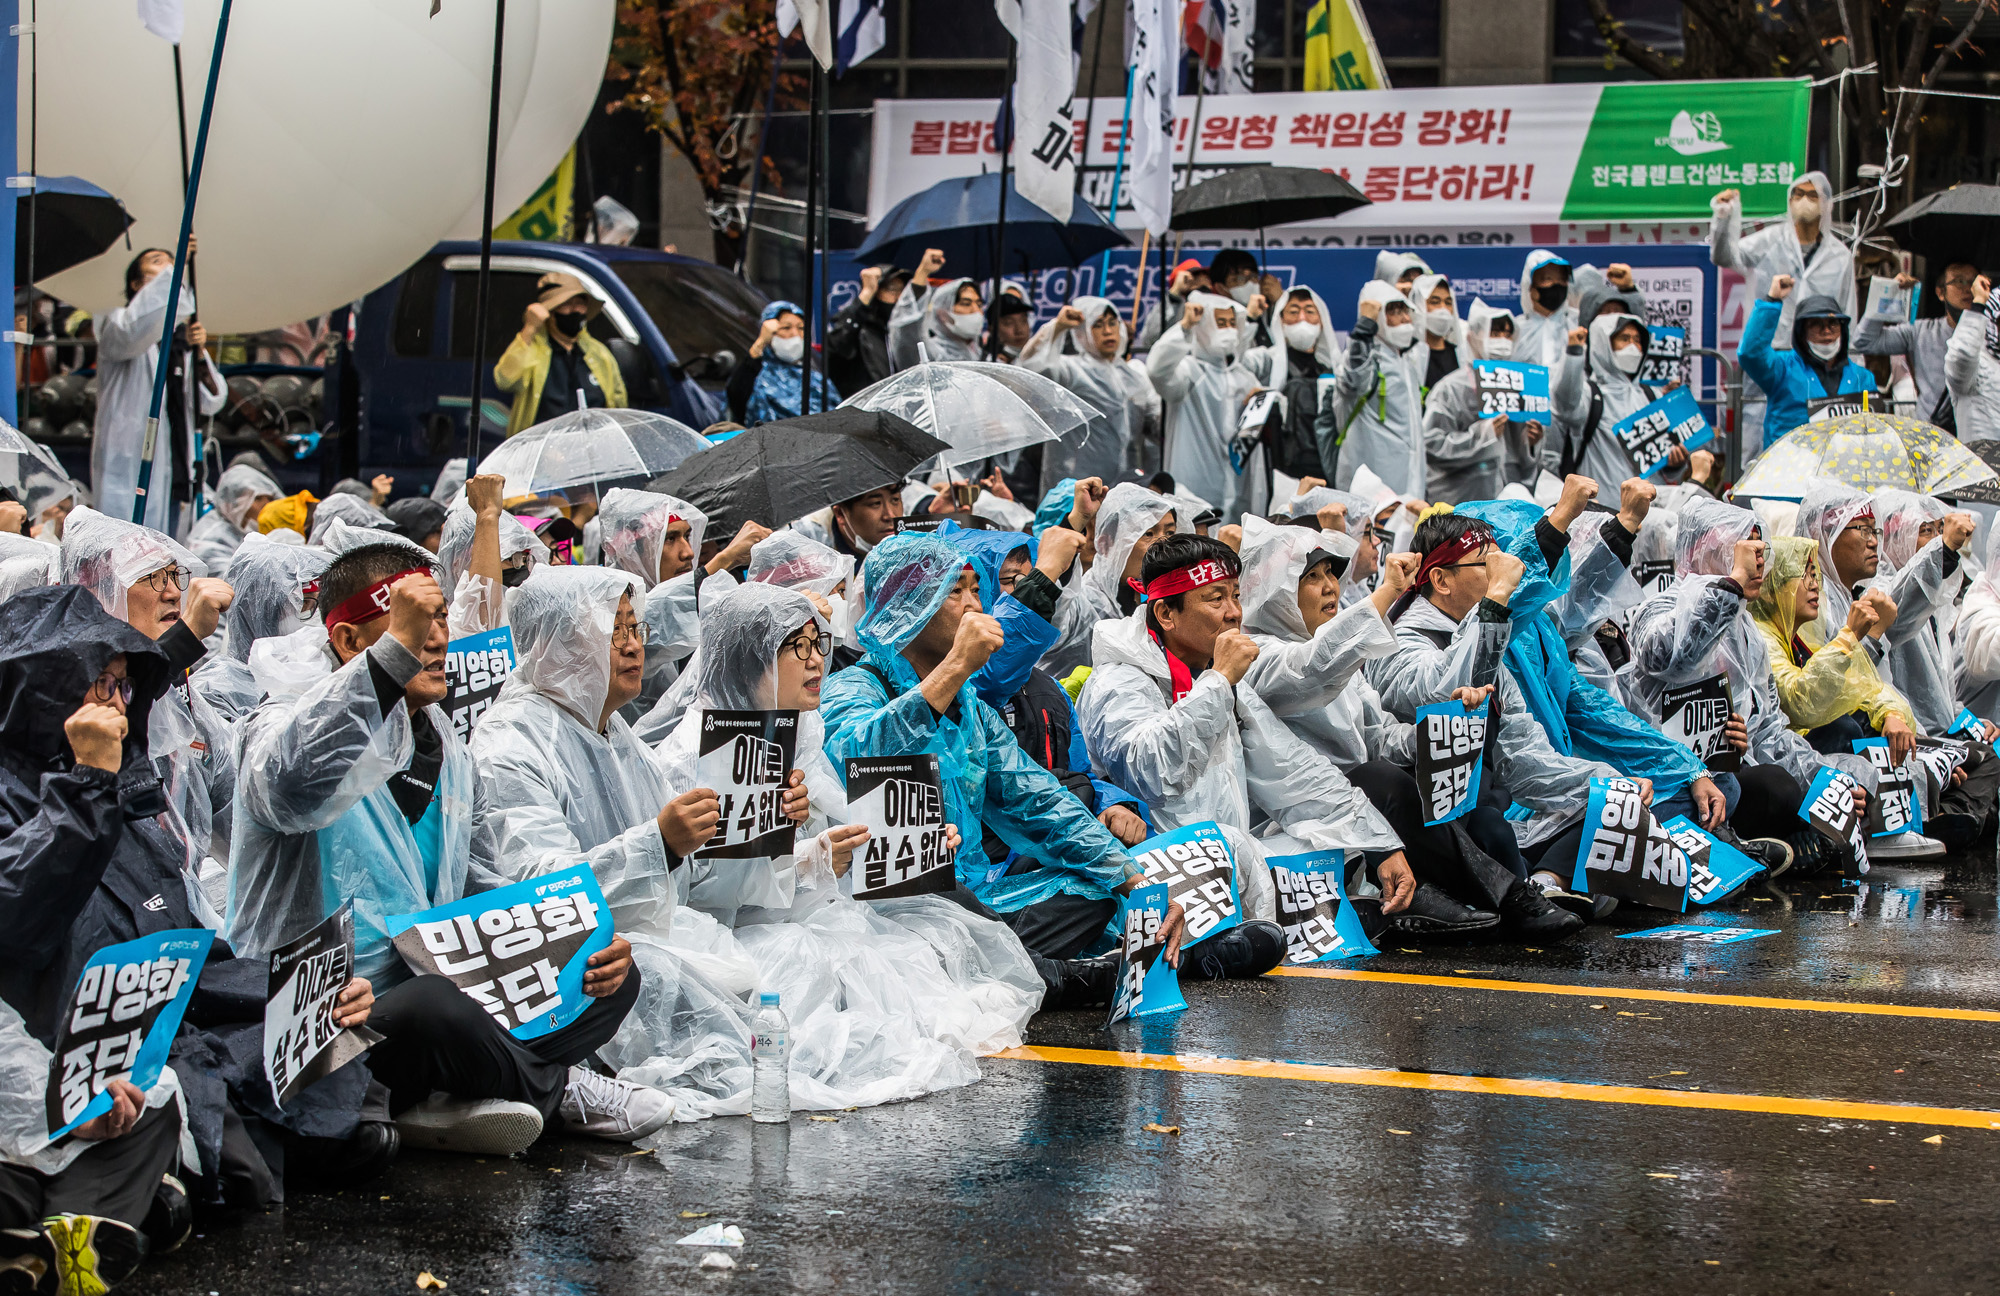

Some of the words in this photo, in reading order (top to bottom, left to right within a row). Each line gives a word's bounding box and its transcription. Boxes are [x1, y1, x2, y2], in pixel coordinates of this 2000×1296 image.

[1201, 115, 1278, 151] 원청
[1289, 110, 1407, 148] 책임성
[1417, 108, 1512, 146] 강화!
[1363, 163, 1535, 202] 중단하라!
[1591, 162, 1796, 187] 전국플랜트건설노동조합
[1478, 364, 1525, 391] 노조법
[1522, 393, 1551, 413] 개정
[1672, 412, 1706, 443] 개정
[1618, 408, 1672, 451] 노조법
[1683, 698, 1729, 737] 이대로
[732, 733, 784, 786] 이대로
[884, 778, 942, 829] 이대로
[1431, 762, 1472, 821] 중단
[737, 792, 756, 842] 수
[864, 836, 890, 890] 살
[894, 834, 915, 881] 수
[1172, 877, 1236, 938] 중단
[1273, 865, 1342, 914] 민영화
[415, 890, 600, 977] 민영화
[1283, 914, 1345, 964] 중단
[70, 956, 191, 1035] 민영화
[293, 943, 347, 1016] 이대로
[293, 1015, 309, 1070] 수
[757, 1037, 772, 1047] 석수
[60, 1028, 144, 1126] 중단
